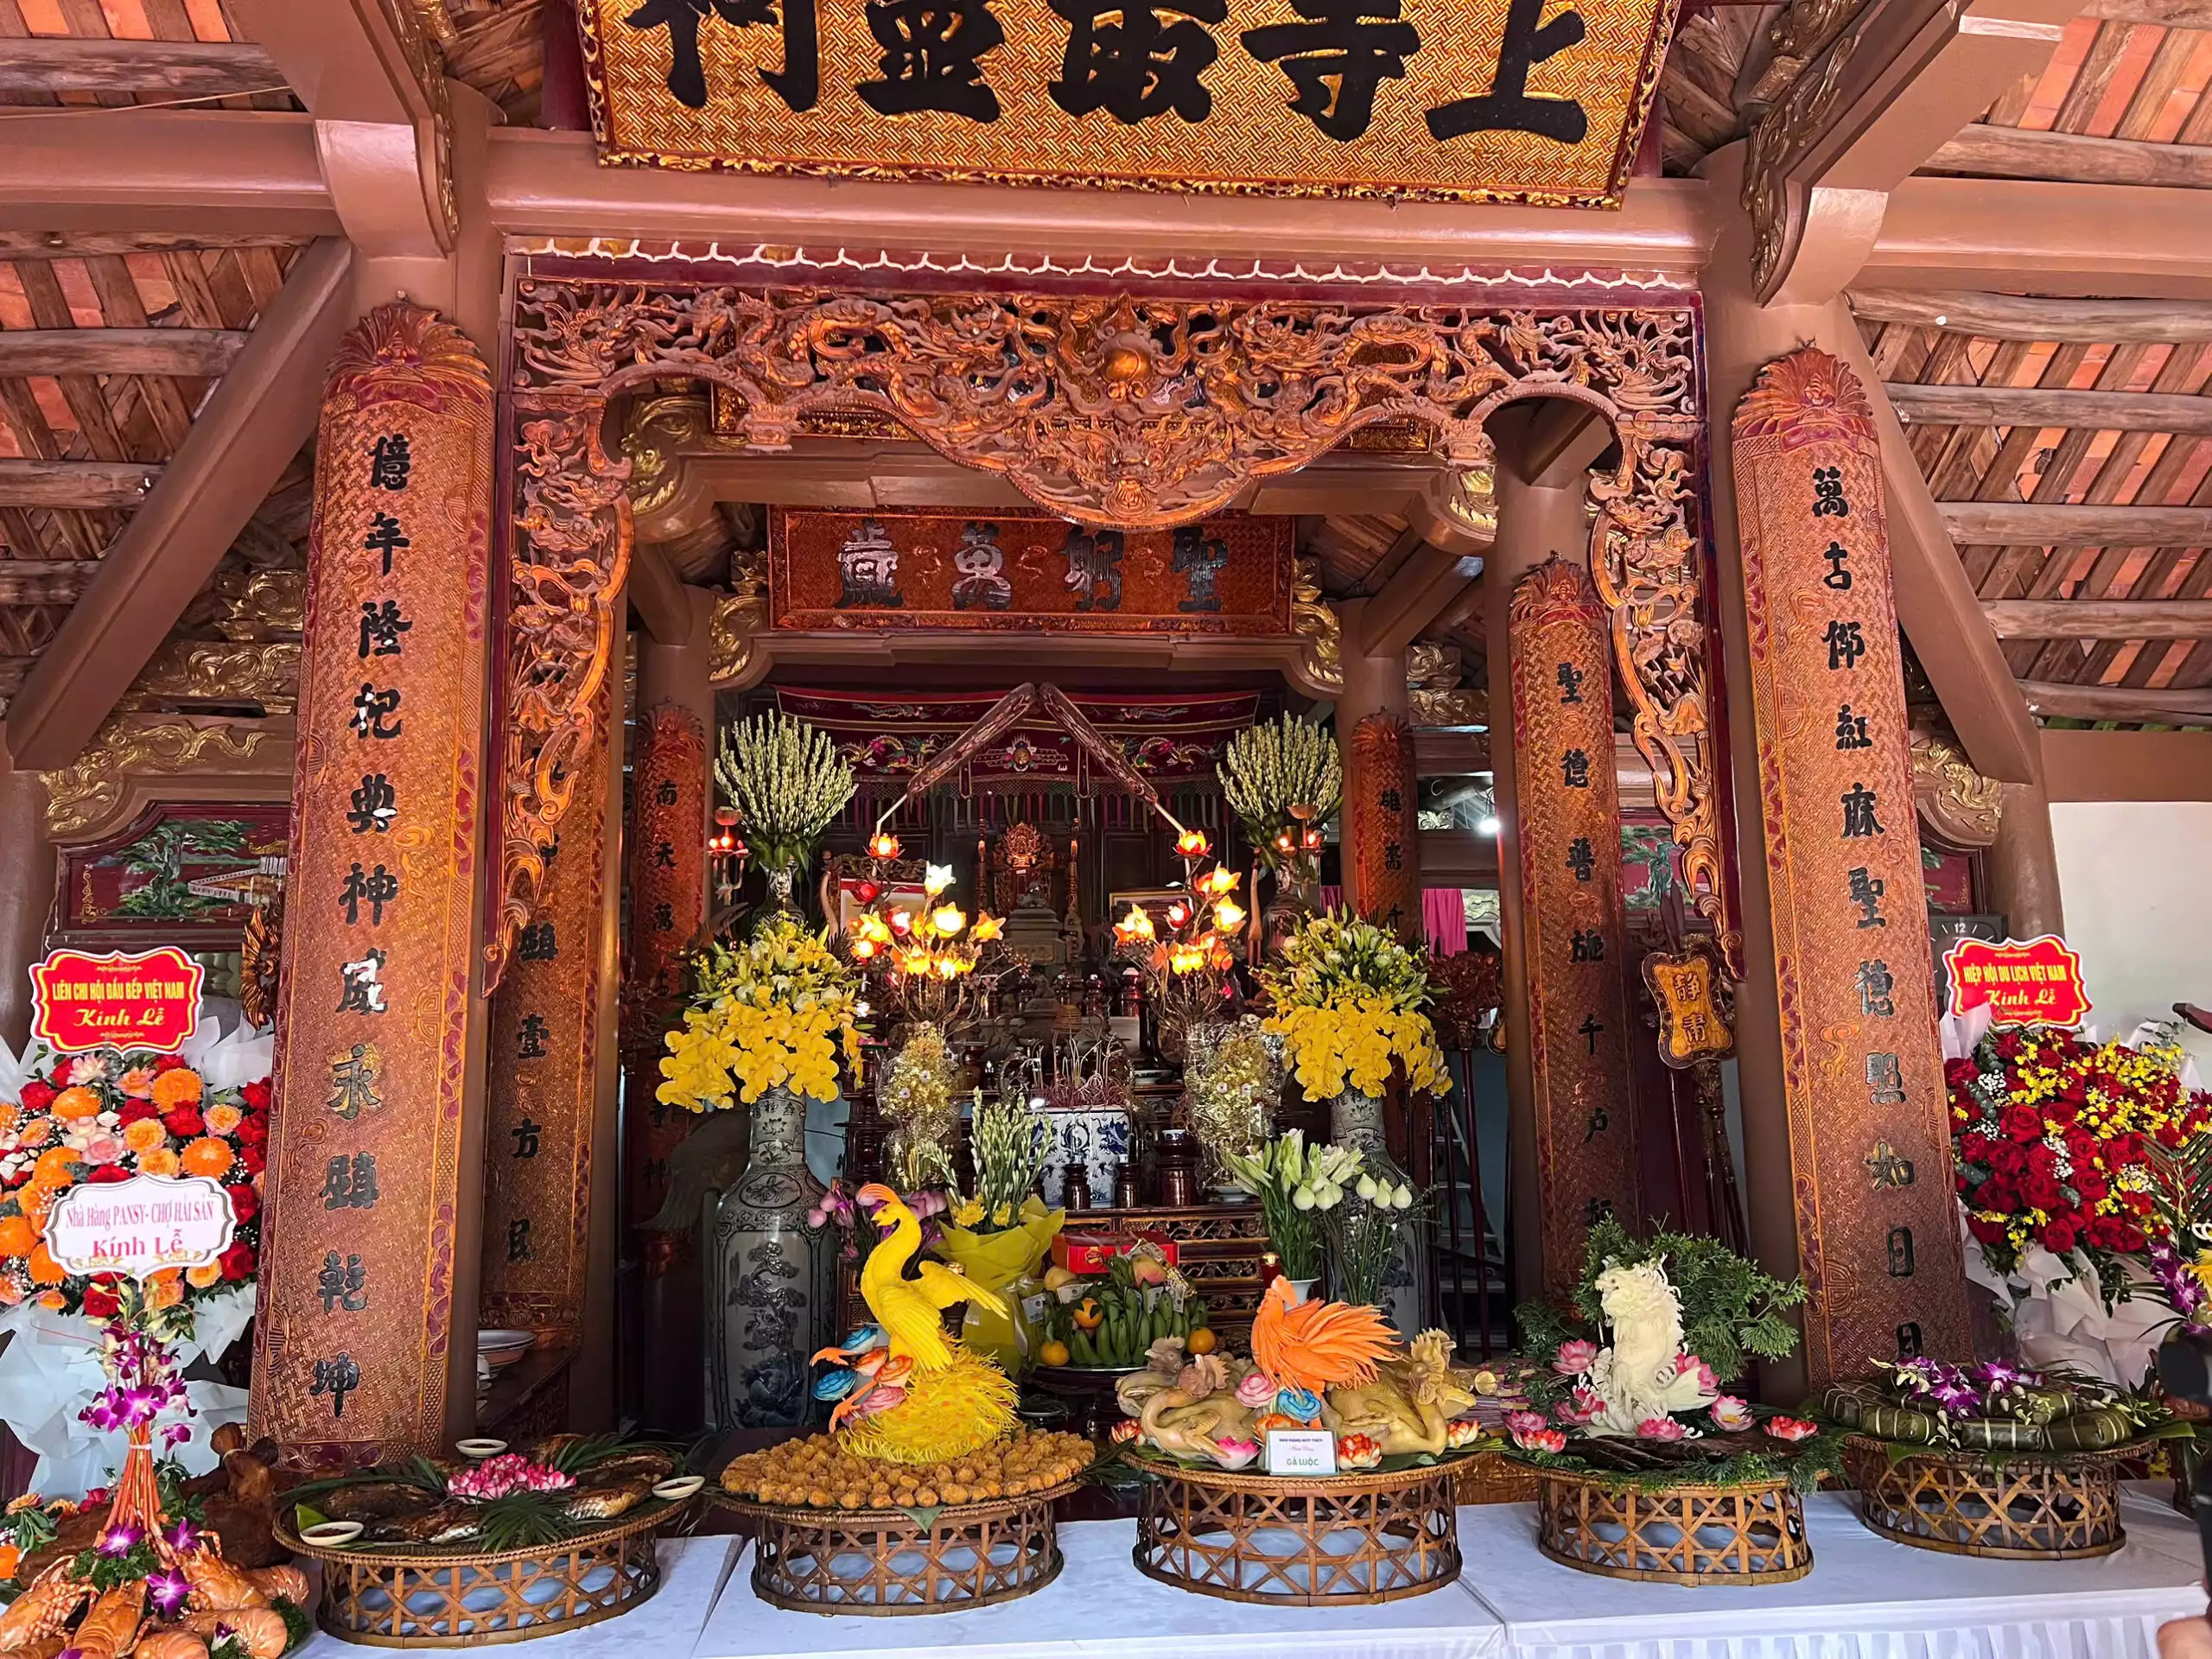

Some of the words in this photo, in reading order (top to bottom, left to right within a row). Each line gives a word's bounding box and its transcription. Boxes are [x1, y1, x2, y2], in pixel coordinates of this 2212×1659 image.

[1954, 923, 1967, 933] 12
[1963, 963, 1981, 986] HIỆP
[1982, 963, 1998, 986] HỘI
[1998, 965, 2010, 982] DU
[2010, 965, 2030, 985] LỊCH
[2029, 962, 2047, 985] VIỆT
[2047, 964, 2067, 982] NAM
[53, 979, 72, 1000] LIÊN
[73, 982, 88, 1001] CHI
[89, 979, 105, 1004] HỘI
[125, 976, 143, 1000] BẾP
[144, 978, 162, 1004] VIỆT
[164, 982, 185, 1000] NAM
[93, 1236, 145, 1258] Kính
[155, 1228, 182, 1255] Lễ
